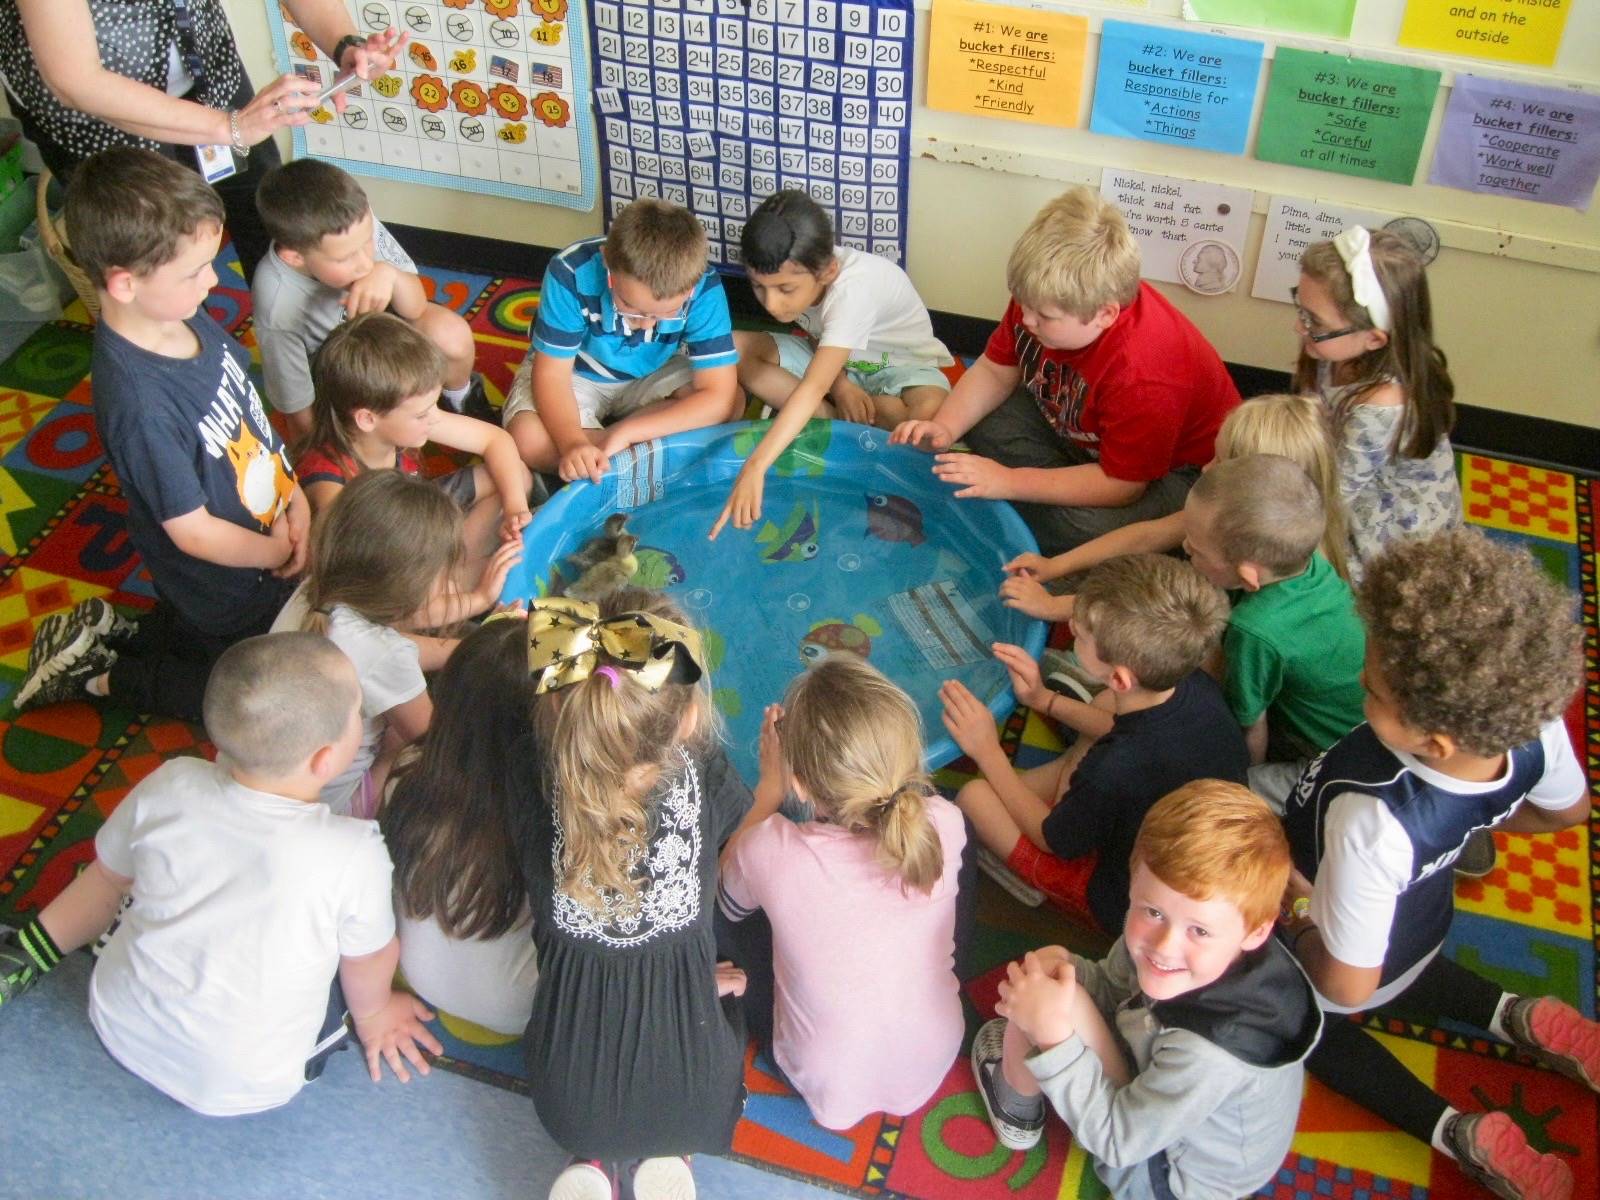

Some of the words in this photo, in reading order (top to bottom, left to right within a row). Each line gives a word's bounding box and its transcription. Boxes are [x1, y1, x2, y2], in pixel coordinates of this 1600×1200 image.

[757, 0, 767, 15] 6
[785, 2, 796, 18] 7
[817, 7, 827, 22] 8
[850, 10, 860, 27] 9
[883, 15, 900, 31] 10
[1450, 7, 1476, 18] and
[1480, 12, 1496, 21] on
[1503, 12, 1526, 25] the
[536, 31, 548, 41] 11
[601, 8, 611, 24] 11
[628, 12, 643, 28] 12
[659, 16, 674, 33] 13
[688, 20, 704, 36] 14
[722, 24, 737, 40] 15
[752, 28, 768, 45] 16
[782, 32, 798, 48] 17
[813, 37, 829, 53] 18
[850, 42, 866, 59] 19
[876, 46, 900, 62] 20
[974, 22, 994, 33] #1:
[1001, 25, 1021, 37] We
[1026, 31, 1048, 41] are
[1456, 29, 1509, 44] outside
[960, 38, 1004, 53] bucket
[1010, 44, 1055, 60] fillers:
[1142, 44, 1166, 56] #2:
[1174, 48, 1194, 61] We
[1199, 55, 1222, 66] are
[454, 60, 467, 71] 16
[543, 72, 553, 82] 18
[603, 37, 616, 54] 21
[627, 42, 647, 59] 22
[656, 46, 676, 63] 23
[688, 50, 710, 67] 24
[718, 54, 740, 71] 25
[750, 58, 772, 76] 26
[780, 64, 802, 81] 27
[812, 68, 834, 86] 28
[842, 73, 865, 90] 29
[878, 76, 901, 92] 30
[1128, 60, 1174, 77] bucket
[1181, 68, 1227, 85] fillers:
[606, 66, 619, 83] 31
[628, 72, 648, 88] 32
[657, 76, 678, 93] 33
[690, 81, 711, 97] 34
[720, 85, 742, 101] 35
[750, 89, 771, 106] 36
[781, 94, 803, 111] 37
[808, 99, 830, 116] 38
[844, 103, 867, 120] 39
[880, 106, 903, 122] 40
[1125, 78, 1202, 101] Responsible
[1207, 91, 1229, 105] for
[1314, 71, 1339, 85] #3:
[1346, 75, 1368, 90] We
[1372, 84, 1396, 95] are
[378, 82, 389, 93] 21
[424, 88, 437, 98] 22
[464, 92, 476, 104] 23
[504, 96, 516, 108] 24
[1299, 88, 1346, 105] bucket
[1353, 97, 1400, 115] fillers:
[1490, 98, 1515, 111] #4:
[1522, 103, 1544, 116] We
[1550, 110, 1574, 121] are
[468, 126, 480, 135] 30
[503, 131, 515, 140] 31
[601, 93, 617, 107] 41
[631, 100, 651, 116] 42
[658, 106, 680, 120] 43
[690, 110, 712, 125] 44
[720, 113, 740, 130] 45
[751, 119, 772, 135] 46
[781, 124, 802, 139] 47
[812, 128, 833, 145] 48
[844, 132, 865, 147] 49
[874, 134, 896, 150] 50
[1474, 113, 1522, 130] bucket
[1529, 123, 1578, 141] fillers:
[610, 123, 622, 139] 51
[633, 128, 652, 144] 52
[662, 134, 682, 149] 53
[690, 137, 711, 152] 54
[722, 144, 742, 159] 55
[753, 149, 774, 165] 56
[783, 153, 803, 168] 57
[811, 157, 832, 173] 58
[841, 161, 863, 176] 59
[873, 164, 896, 178] 60
[1300, 149, 1314, 159] at
[1319, 151, 1335, 162] all
[1340, 152, 1376, 168] times
[614, 151, 627, 166] 61
[638, 156, 657, 172] 62
[663, 161, 684, 176] 63
[691, 166, 710, 181] 64
[722, 169, 742, 185] 65
[753, 176, 774, 192] 66
[812, 185, 833, 200] 68
[842, 189, 864, 204] 69
[874, 191, 895, 205] 70
[1527, 163, 1554, 175] well
[1480, 173, 1540, 192] together
[614, 176, 627, 191] 71
[638, 183, 656, 197] 72
[666, 187, 684, 202] 73
[695, 192, 714, 207] 74
[724, 197, 743, 212] 75
[844, 216, 866, 230] 79
[874, 218, 896, 232] 80
[1118, 194, 1145, 206] thick
[1154, 200, 1173, 210] and
[1146, 215, 1176, 226] worth
[1181, 218, 1189, 227] 5
[1285, 220, 1310, 233] little
